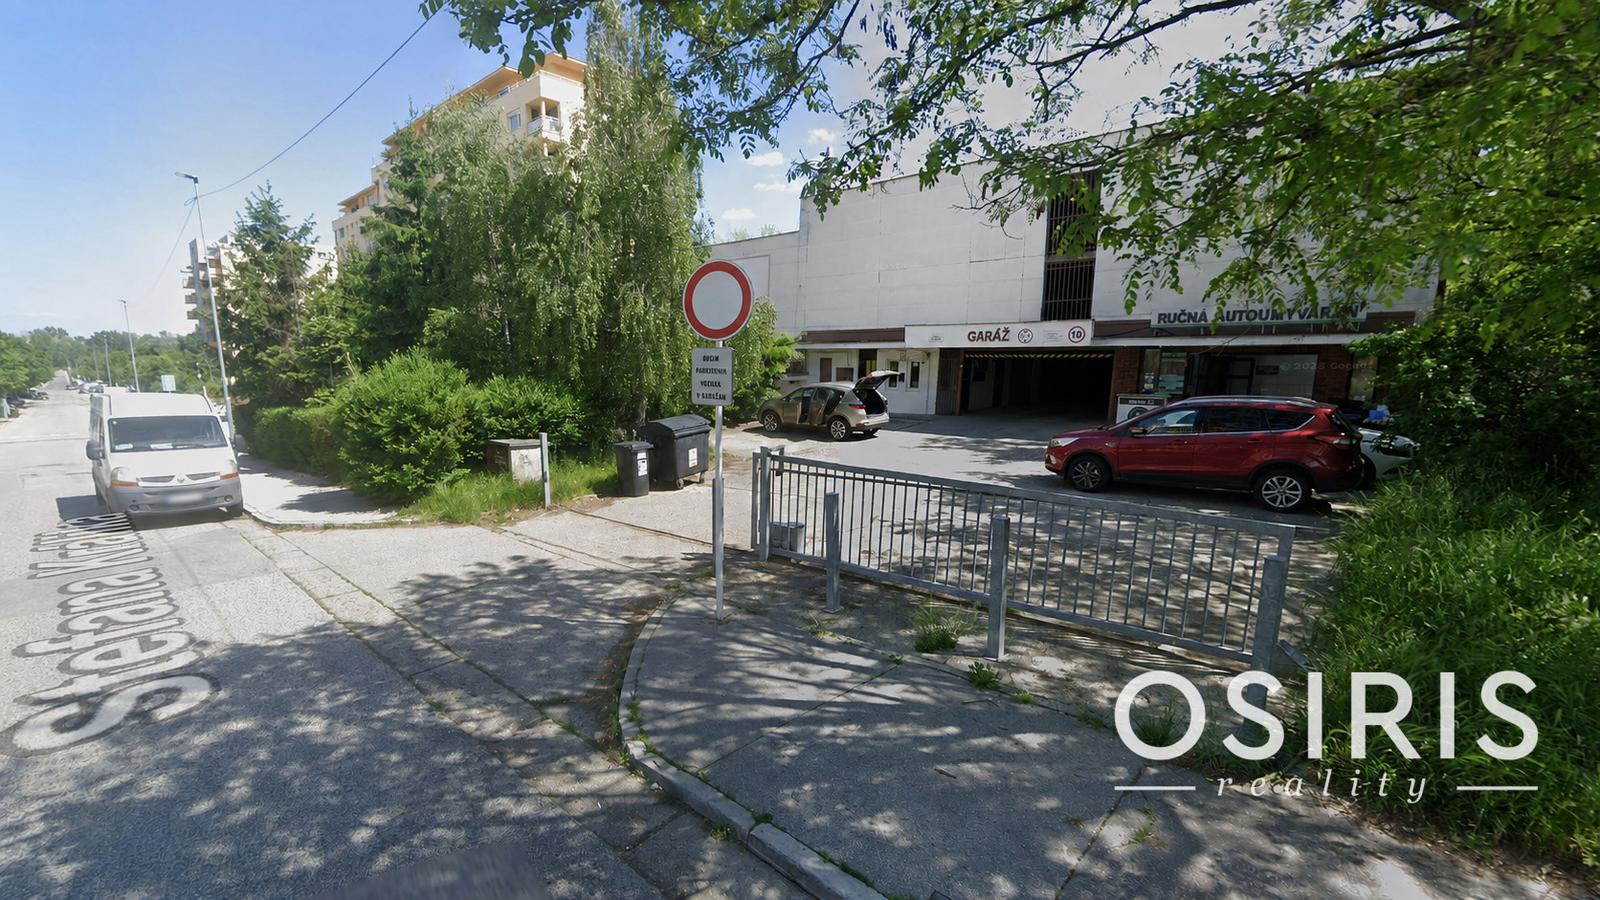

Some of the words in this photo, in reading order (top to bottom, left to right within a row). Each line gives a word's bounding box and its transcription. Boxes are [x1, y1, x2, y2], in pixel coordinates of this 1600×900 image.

[1157, 308, 1208, 324] RUČNÁ
[1217, 304, 1360, 322] UTOUMYVAR
[967, 327, 1010, 342] GARÁŽ
[1071, 330, 1083, 339] 10
